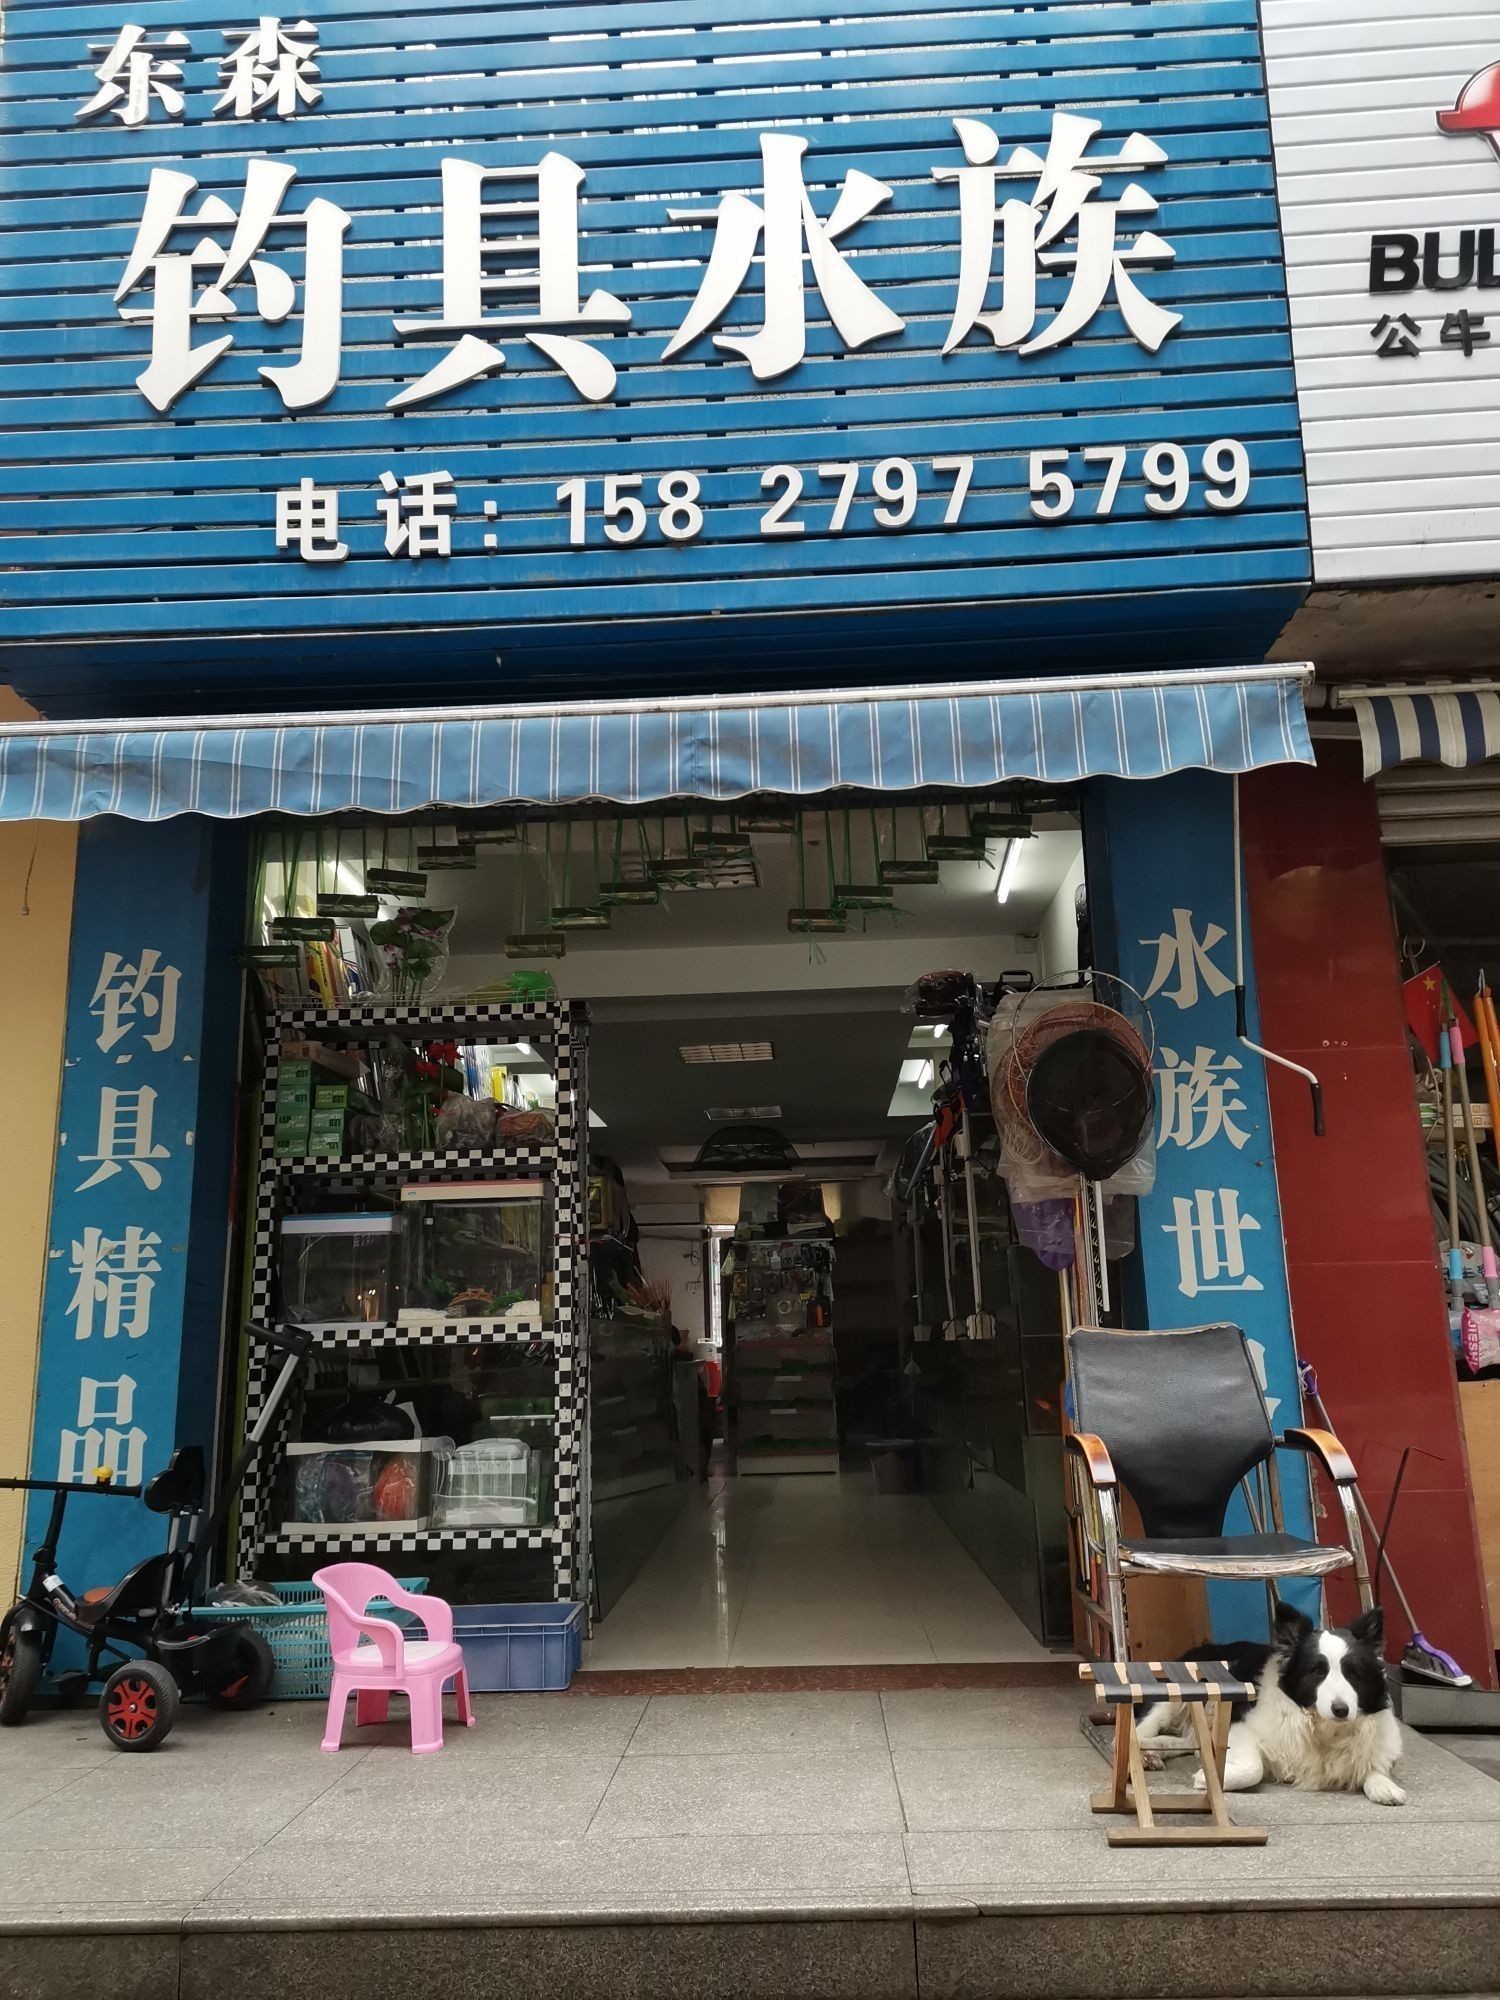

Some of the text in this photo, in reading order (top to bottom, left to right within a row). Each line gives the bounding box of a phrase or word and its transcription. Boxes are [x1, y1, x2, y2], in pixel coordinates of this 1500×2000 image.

[76, 16, 323, 127] 东森
[113, 113, 1184, 412] 钓具水族
[1370, 309, 1491, 357] 公牛
[556, 470, 702, 545] 158
[759, 456, 974, 534] 2797
[1029, 438, 1251, 520] 5799
[57, 949, 182, 1487] 钓具精品
[1138, 908, 1281, 1420] 水族世
